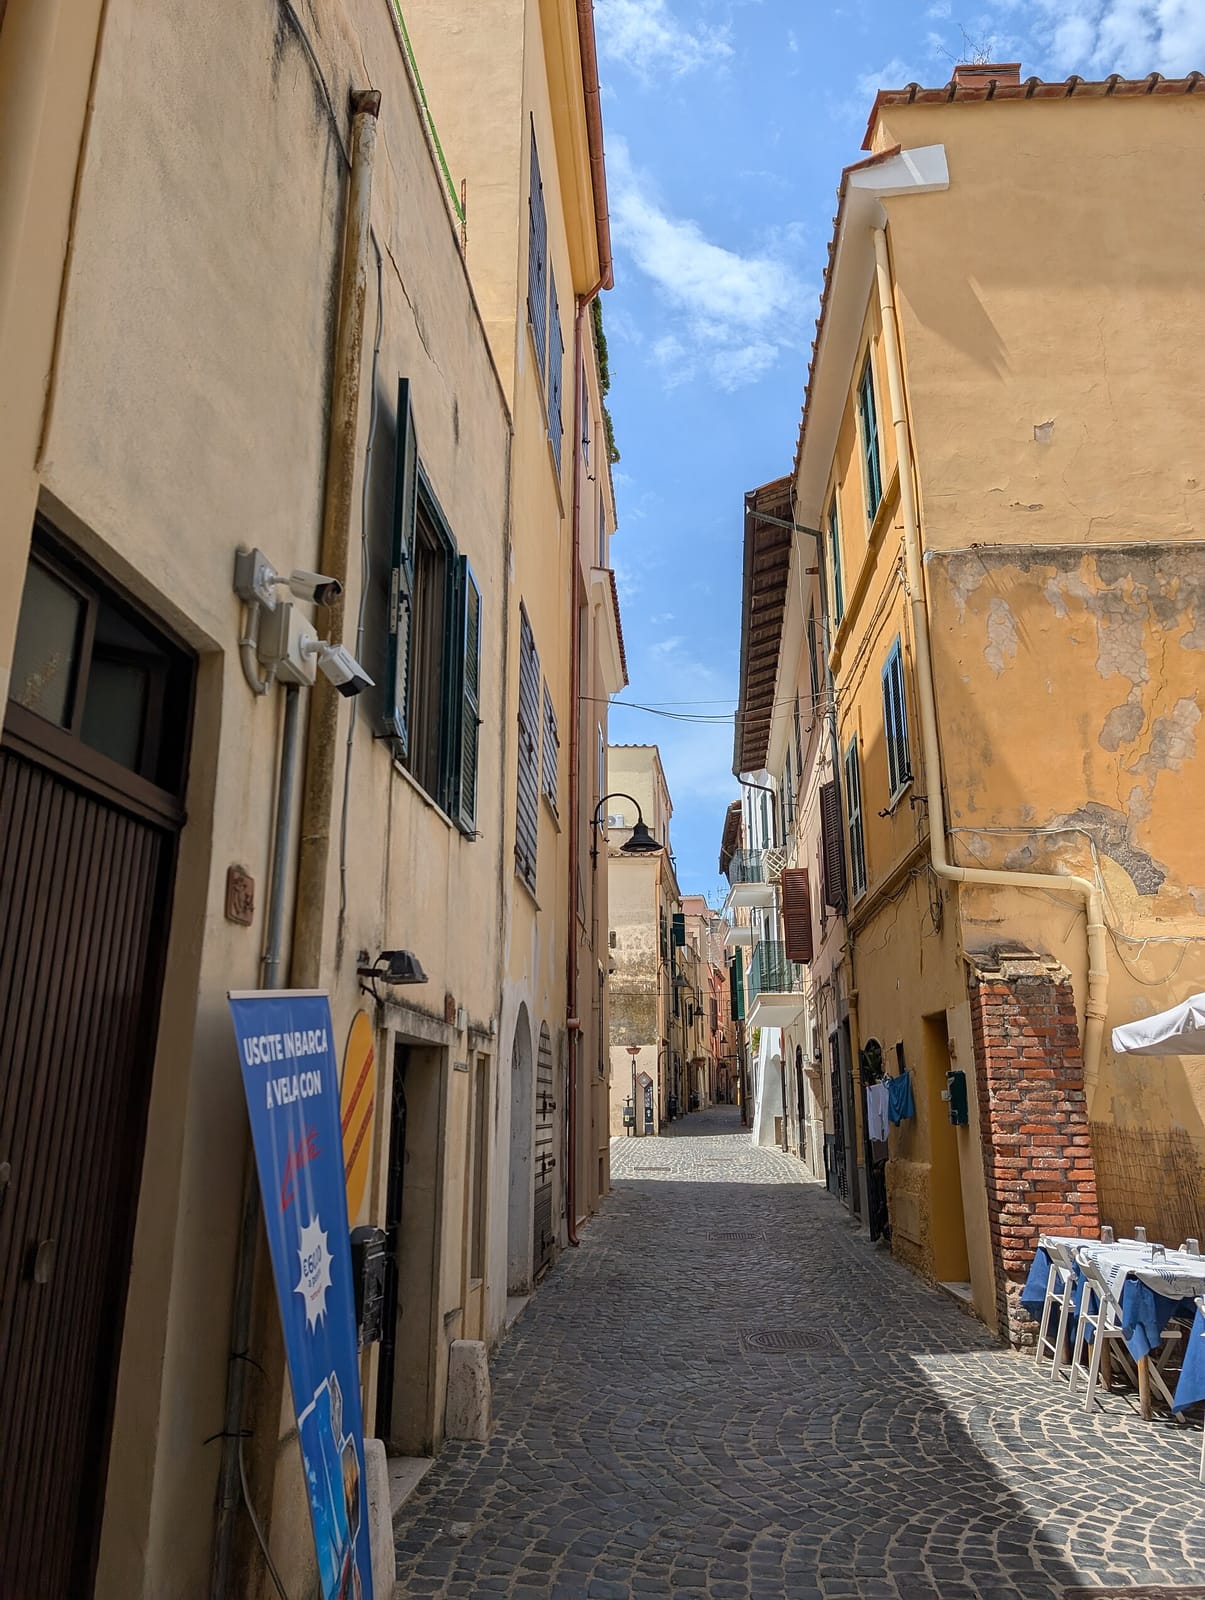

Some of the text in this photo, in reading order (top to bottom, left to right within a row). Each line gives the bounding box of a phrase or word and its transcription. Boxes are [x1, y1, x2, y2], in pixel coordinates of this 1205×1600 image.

[243, 1028, 328, 1066] USCITE IN BARCA
[266, 1070, 322, 1109] A VELA CON
